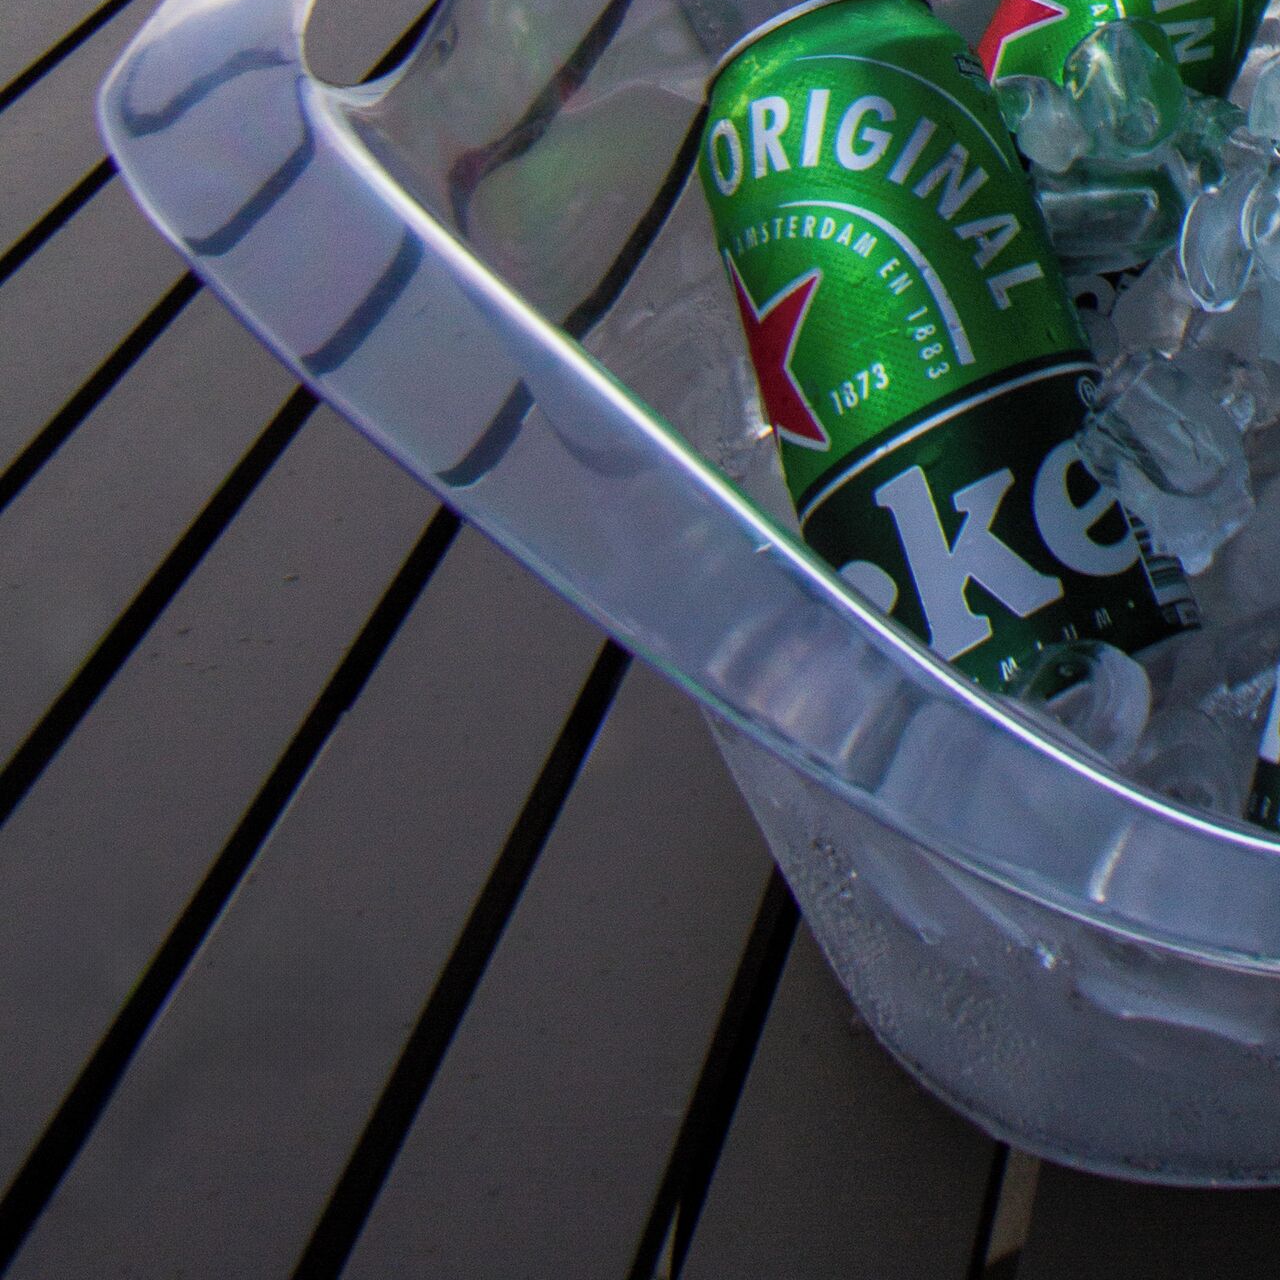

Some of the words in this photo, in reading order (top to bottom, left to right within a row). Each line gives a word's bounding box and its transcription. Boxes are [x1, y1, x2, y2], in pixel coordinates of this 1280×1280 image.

[709, 88, 1045, 311] ORIGINAL
[735, 214, 878, 258] AMSTERDAM
[879, 257, 914, 296] EN
[905, 305, 951, 380] 1883
[829, 361, 890, 417] 1873
